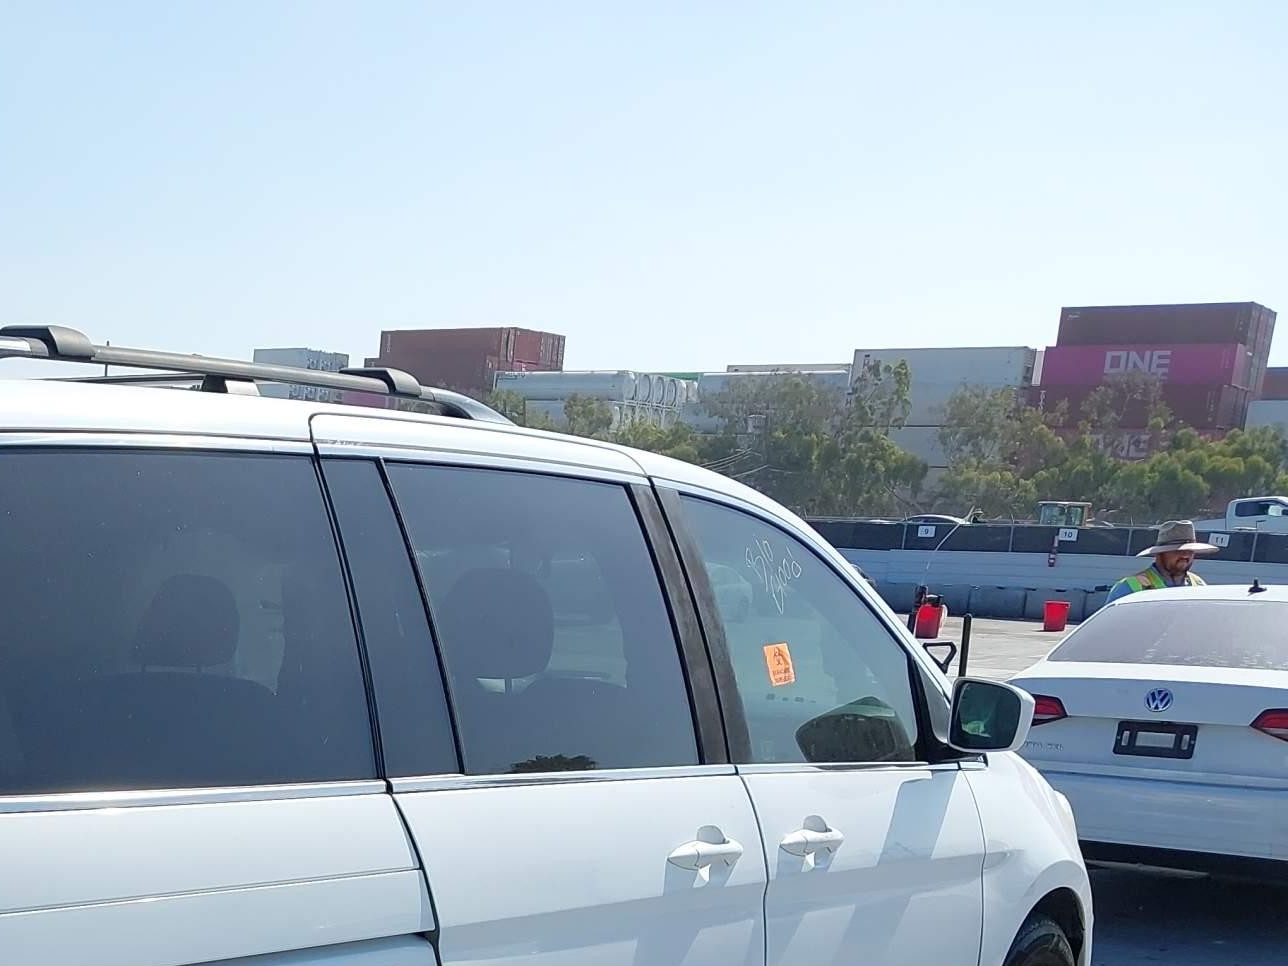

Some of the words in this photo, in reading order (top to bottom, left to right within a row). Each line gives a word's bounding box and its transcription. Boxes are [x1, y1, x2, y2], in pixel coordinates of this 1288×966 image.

[1103, 350, 1172, 374] ONE
[1063, 531, 1073, 539] 10
[1215, 536, 1225, 545] 11
